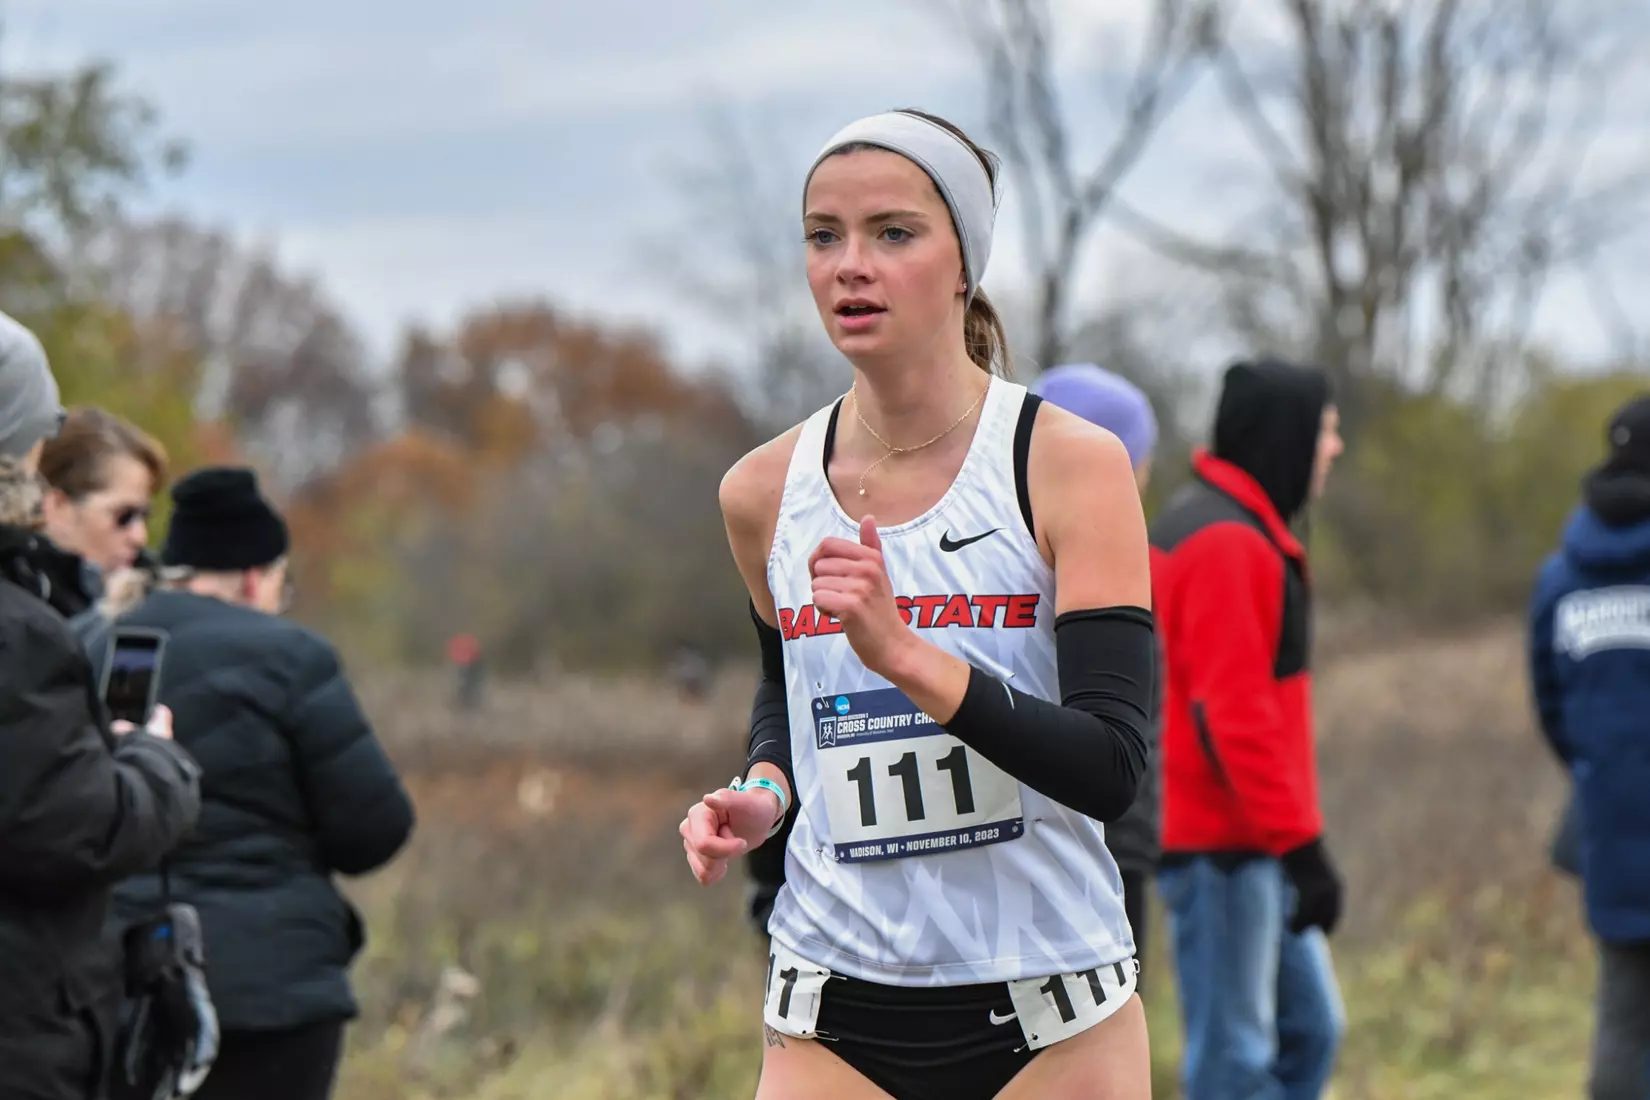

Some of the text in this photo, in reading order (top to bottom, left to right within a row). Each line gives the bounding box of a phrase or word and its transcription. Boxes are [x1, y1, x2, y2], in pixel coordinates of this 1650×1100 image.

[778, 593, 1040, 642] BAL STATE
[836, 719, 866, 734] CROSS
[867, 713, 913, 730] COUNTRY
[846, 745, 976, 827] 111
[887, 843, 899, 854] WI
[906, 836, 957, 851] NOVEMBER
[959, 833, 972, 844] 10,
[974, 828, 1000, 842] 2023
